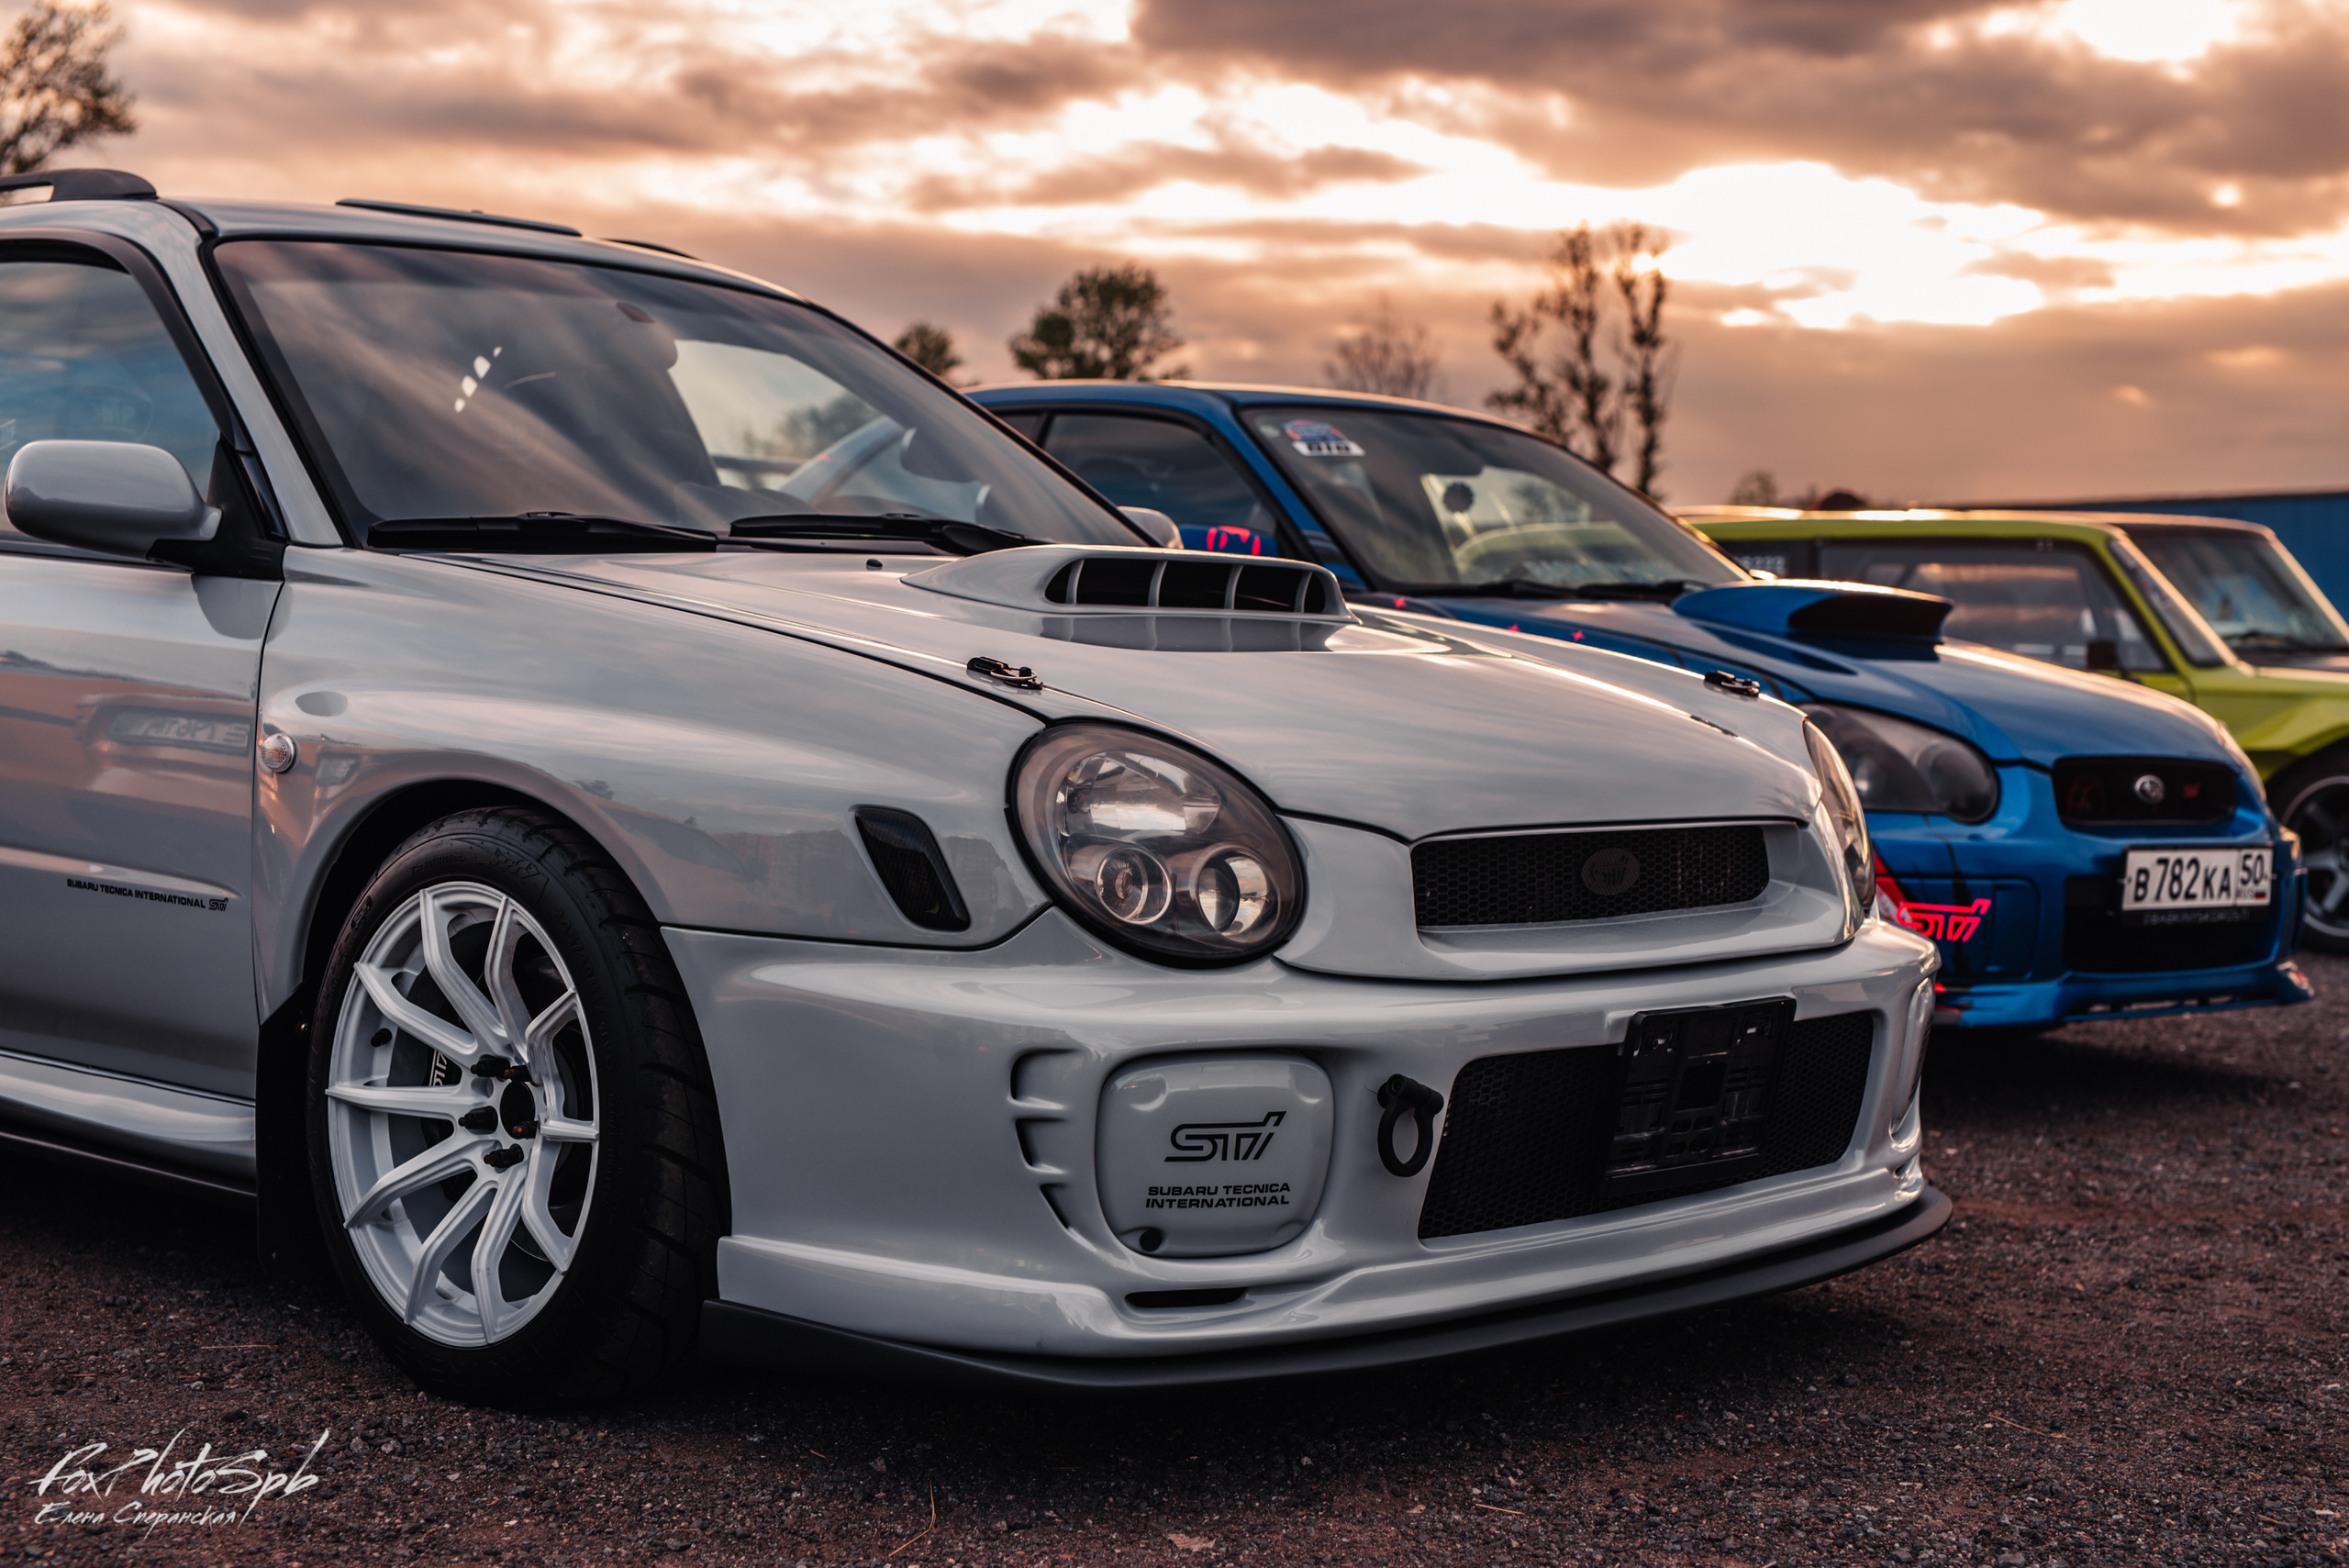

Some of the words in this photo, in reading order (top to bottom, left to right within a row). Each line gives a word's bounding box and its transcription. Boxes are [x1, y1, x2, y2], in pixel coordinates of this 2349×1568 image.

[2240, 853, 2265, 885] 50
[67, 878, 98, 892] SUBARU
[100, 884, 133, 897] TECNICA
[135, 889, 206, 908] INTERNATIONAL
[1148, 1185, 1219, 1196] SUBARU
[1223, 1182, 1291, 1195] TECNICA
[1146, 1195, 1290, 1209] INTERNATIONAL
